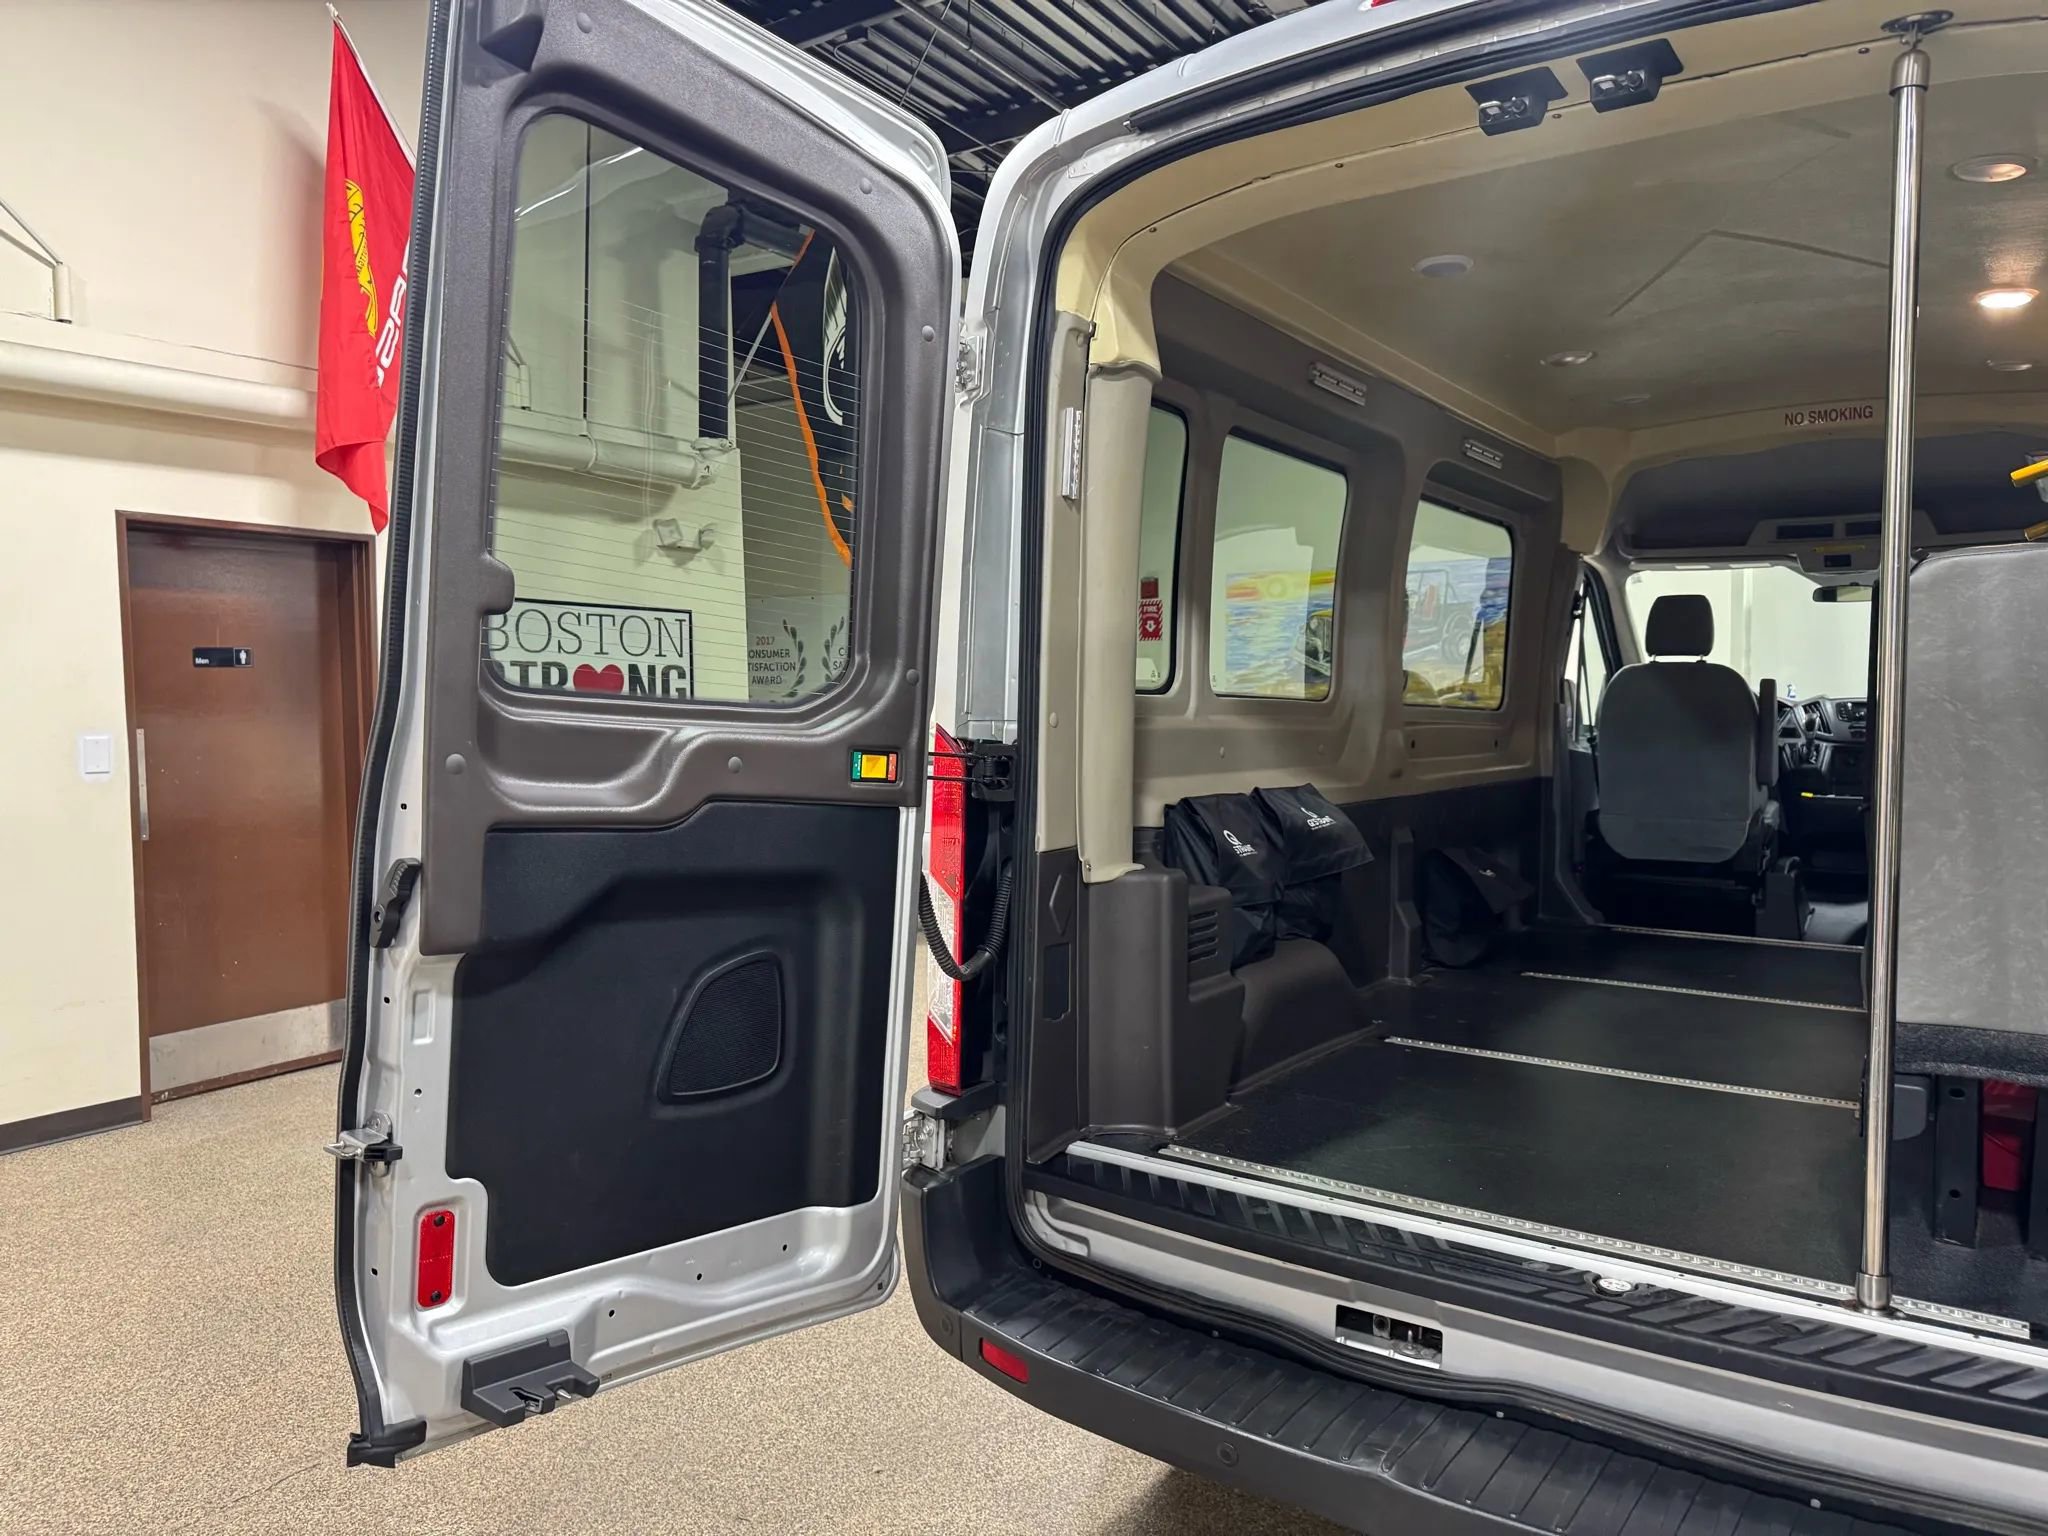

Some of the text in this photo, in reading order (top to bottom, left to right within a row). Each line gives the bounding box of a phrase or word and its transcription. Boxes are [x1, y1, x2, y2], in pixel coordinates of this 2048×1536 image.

[1784, 405, 1873, 426] NO SMOKING
[755, 636, 776, 646] 2017
[748, 648, 791, 659] ONSUMER
[195, 657, 210, 665] Men
[748, 661, 797, 672] TISFACTION
[751, 675, 783, 685] AWARD
